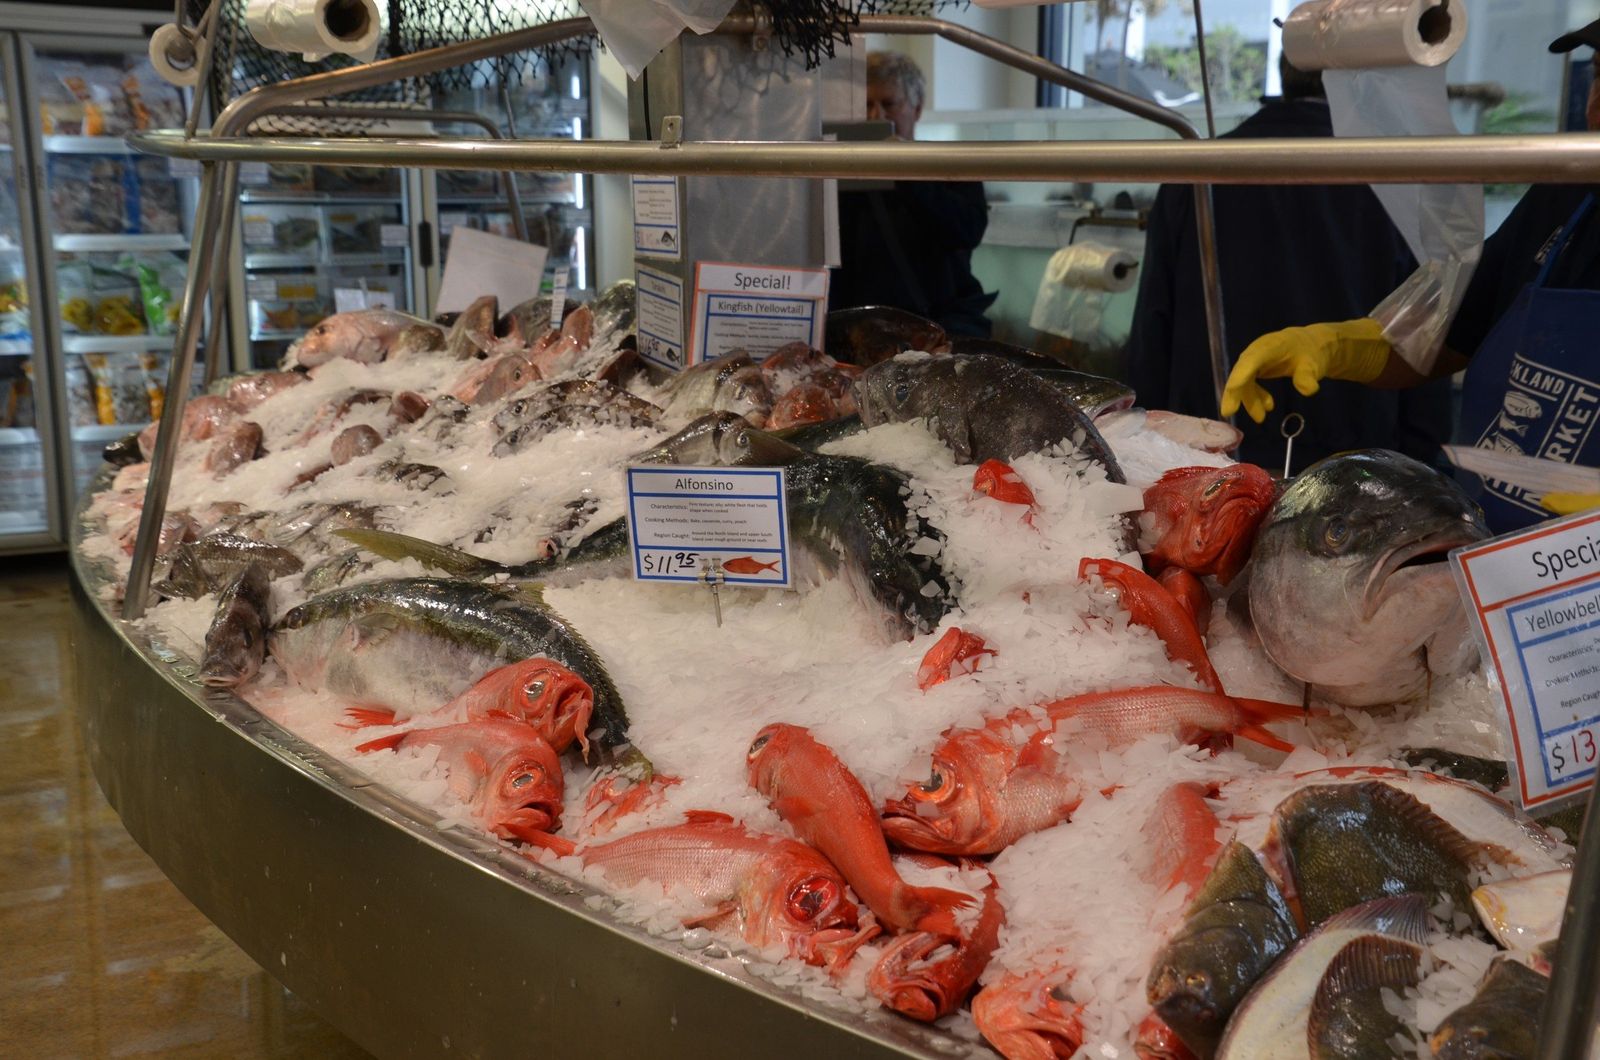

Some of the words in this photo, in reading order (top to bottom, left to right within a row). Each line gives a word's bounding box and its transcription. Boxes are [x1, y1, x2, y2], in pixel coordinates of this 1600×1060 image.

[734, 272, 791, 290] Special!
[718, 301, 753, 313] Kingfish
[755, 302, 804, 315] (Yellowtail)
[1511, 360, 1566, 395] KLAND
[675, 478, 734, 491] Alfonsino
[1525, 594, 1600, 632] Yellowbel
[1560, 696, 1581, 709] Region
